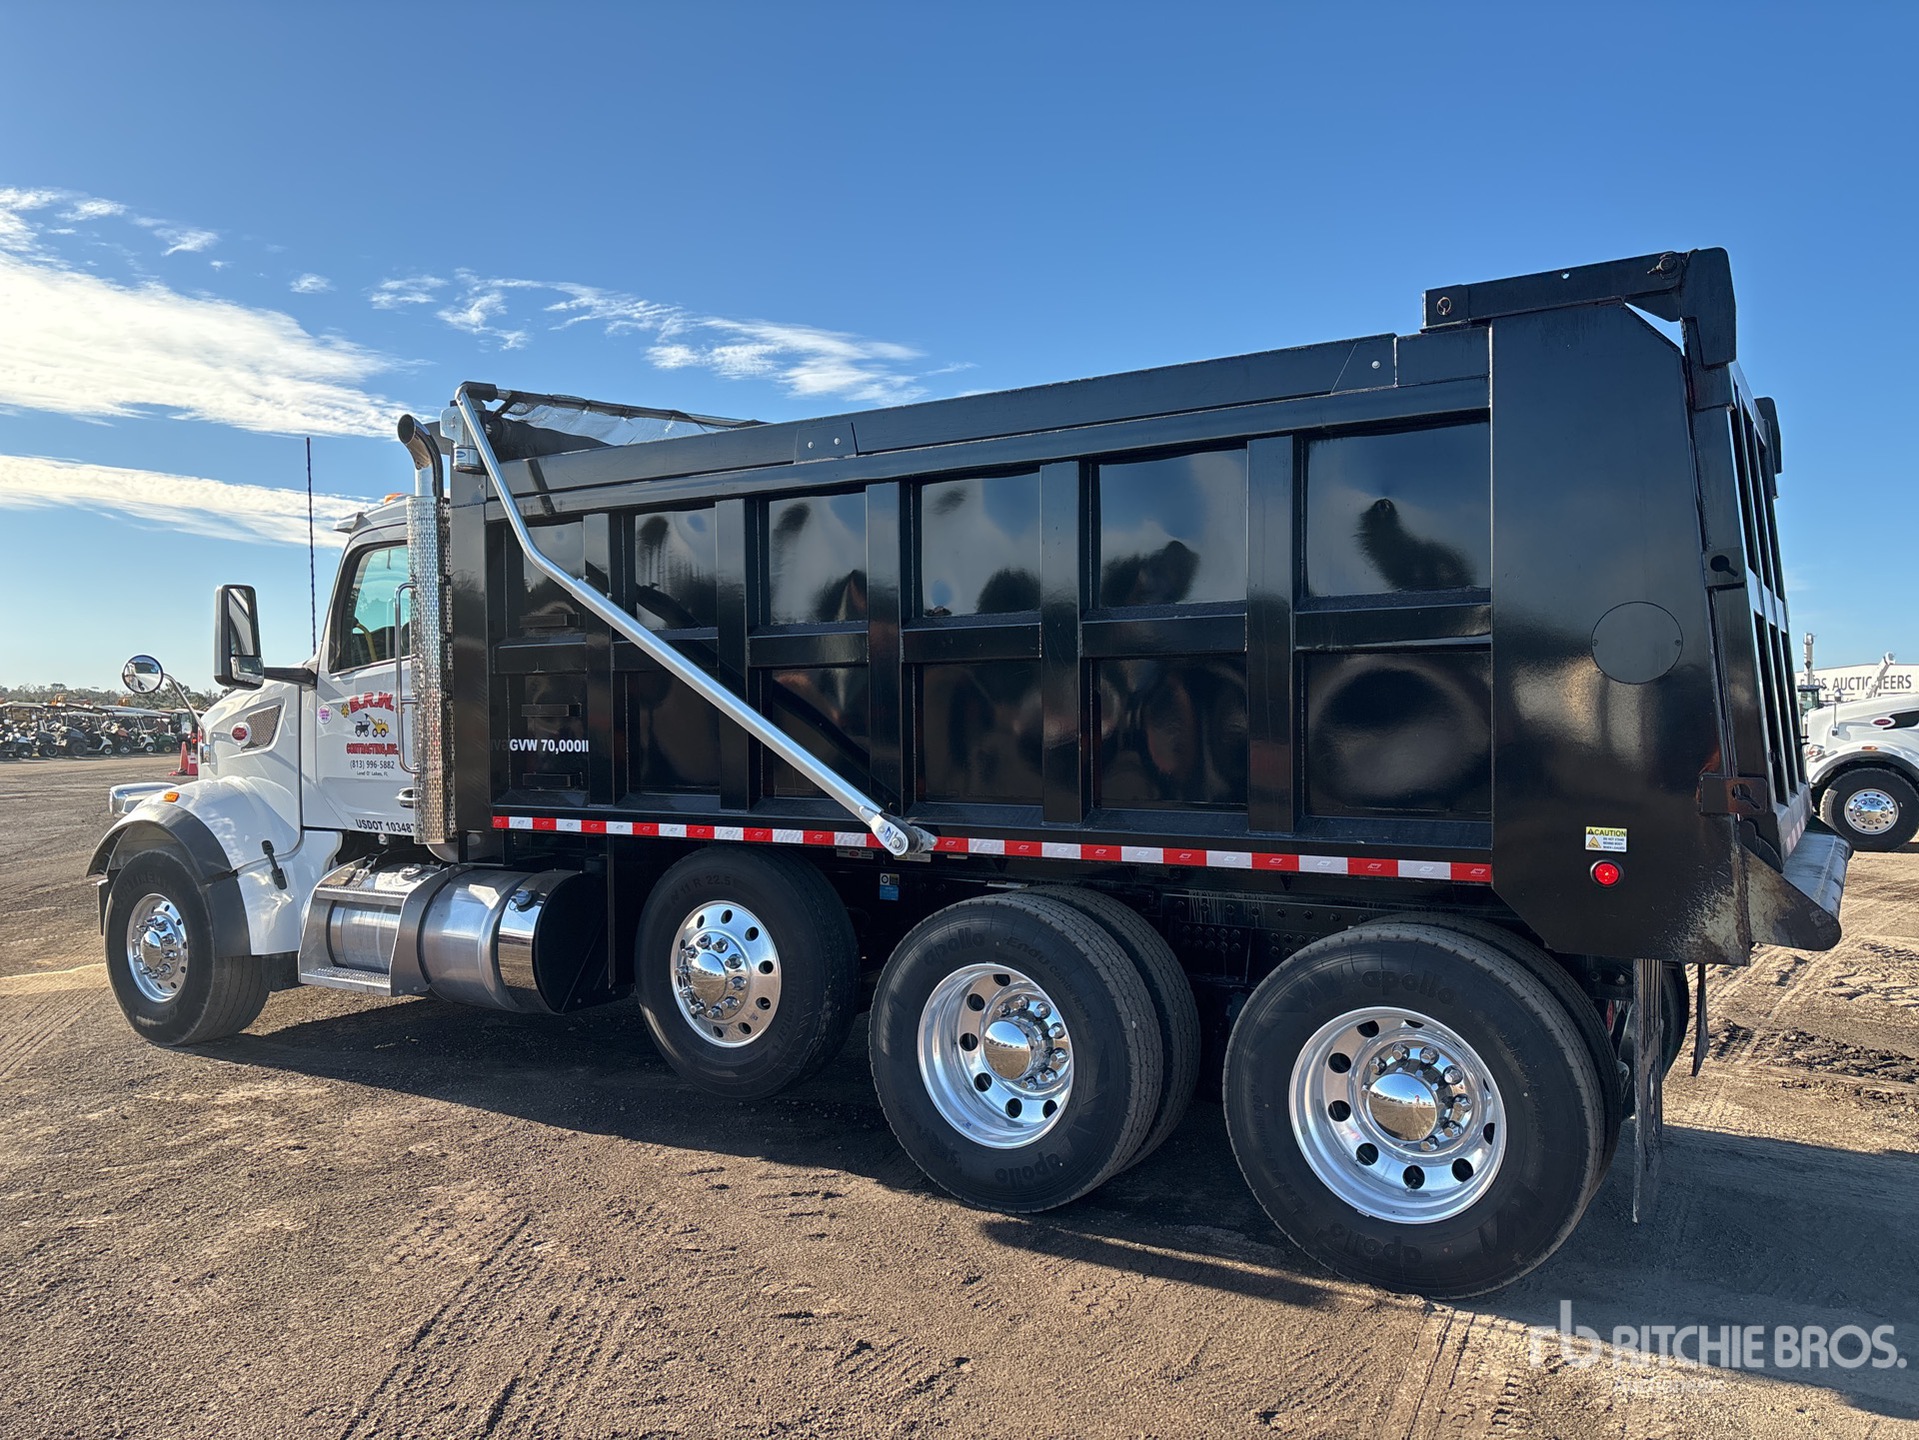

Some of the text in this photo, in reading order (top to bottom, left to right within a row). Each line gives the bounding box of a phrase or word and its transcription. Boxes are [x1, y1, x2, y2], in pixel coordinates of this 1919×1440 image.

[1832, 674, 1912, 691] AUCTIEERS
[349, 691, 395, 714] B.R.W.
[509, 739, 538, 751] GVW
[350, 760, 395, 770] (813) 996-5882
[355, 819, 384, 831] USDOT
[1594, 828, 1626, 837] CAUTION
